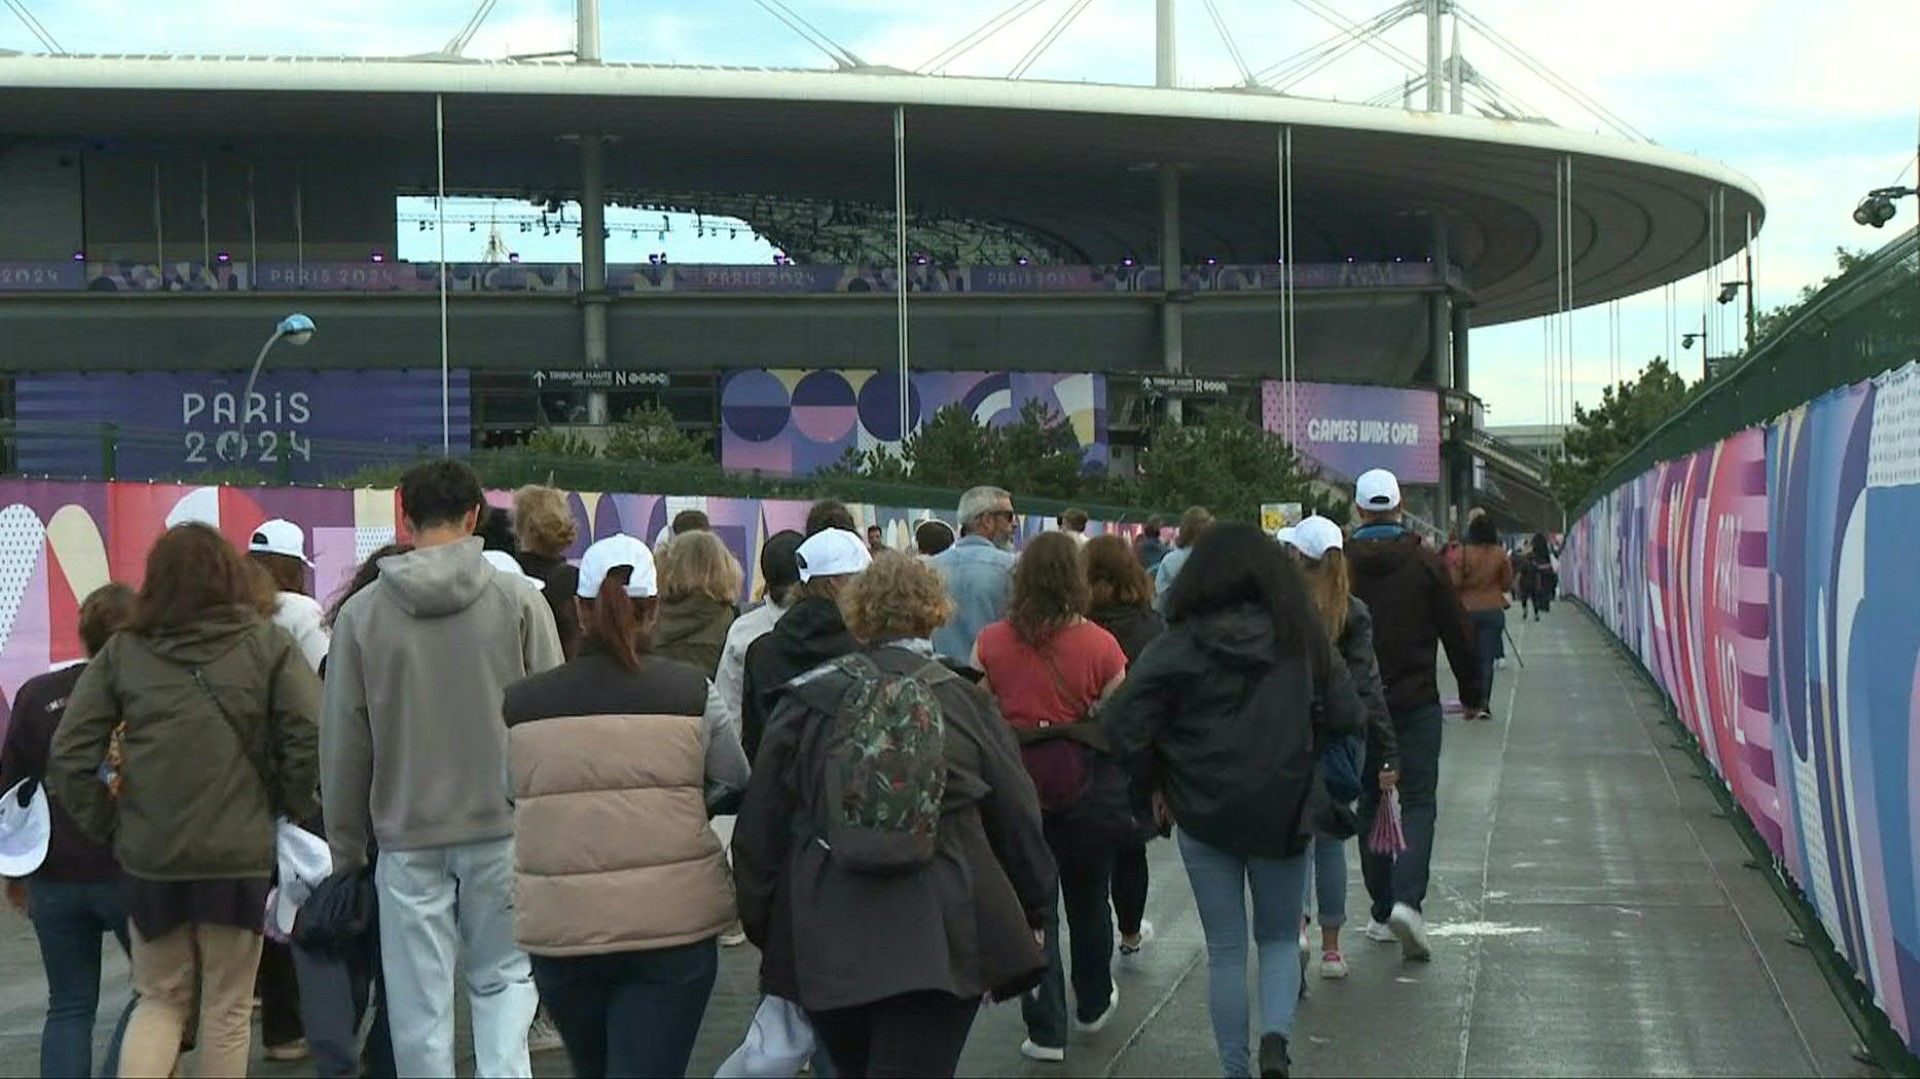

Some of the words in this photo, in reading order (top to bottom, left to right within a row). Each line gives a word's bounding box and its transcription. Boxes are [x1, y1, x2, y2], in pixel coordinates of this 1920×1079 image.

[270, 268, 331, 284] PARIS
[338, 268, 393, 284] 2024
[615, 370, 627, 387] N
[1307, 417, 1359, 443] GAMES
[1359, 419, 1391, 444] WIDE
[1391, 421, 1419, 445] OPEN
[184, 430, 311, 462] 2024
